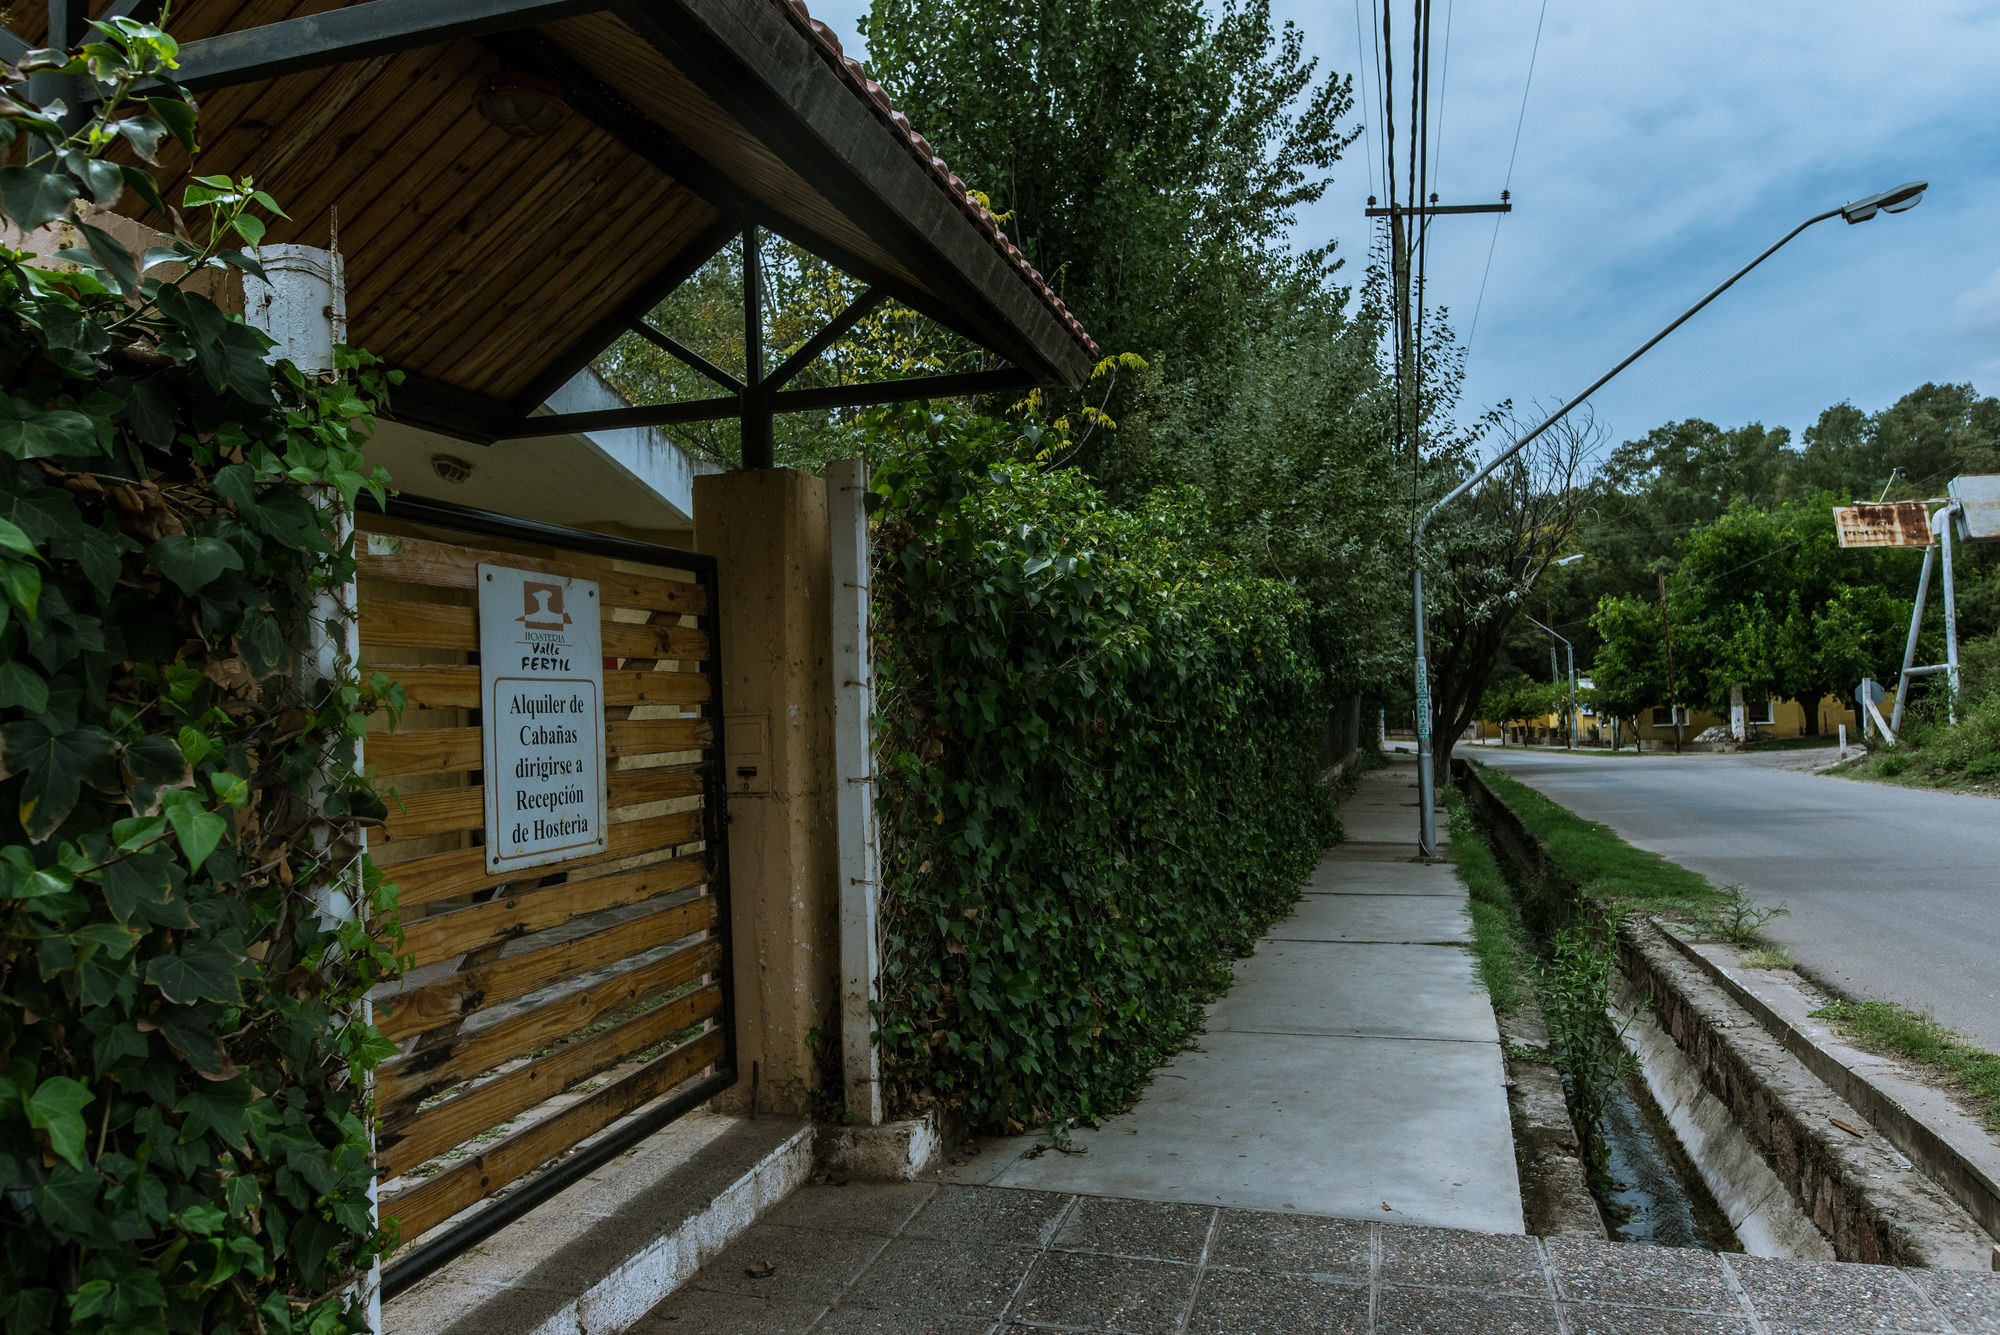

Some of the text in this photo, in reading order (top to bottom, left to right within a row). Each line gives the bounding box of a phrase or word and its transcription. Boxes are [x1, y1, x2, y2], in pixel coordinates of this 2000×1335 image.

[532, 642, 560, 655] Valle
[521, 656, 571, 671] FERTIL
[510, 694, 584, 720] Alquiler de
[519, 724, 578, 746] Cabañas
[515, 756, 583, 782] dirigirse a
[516, 784, 584, 812] Recepción
[512, 823, 529, 844] de
